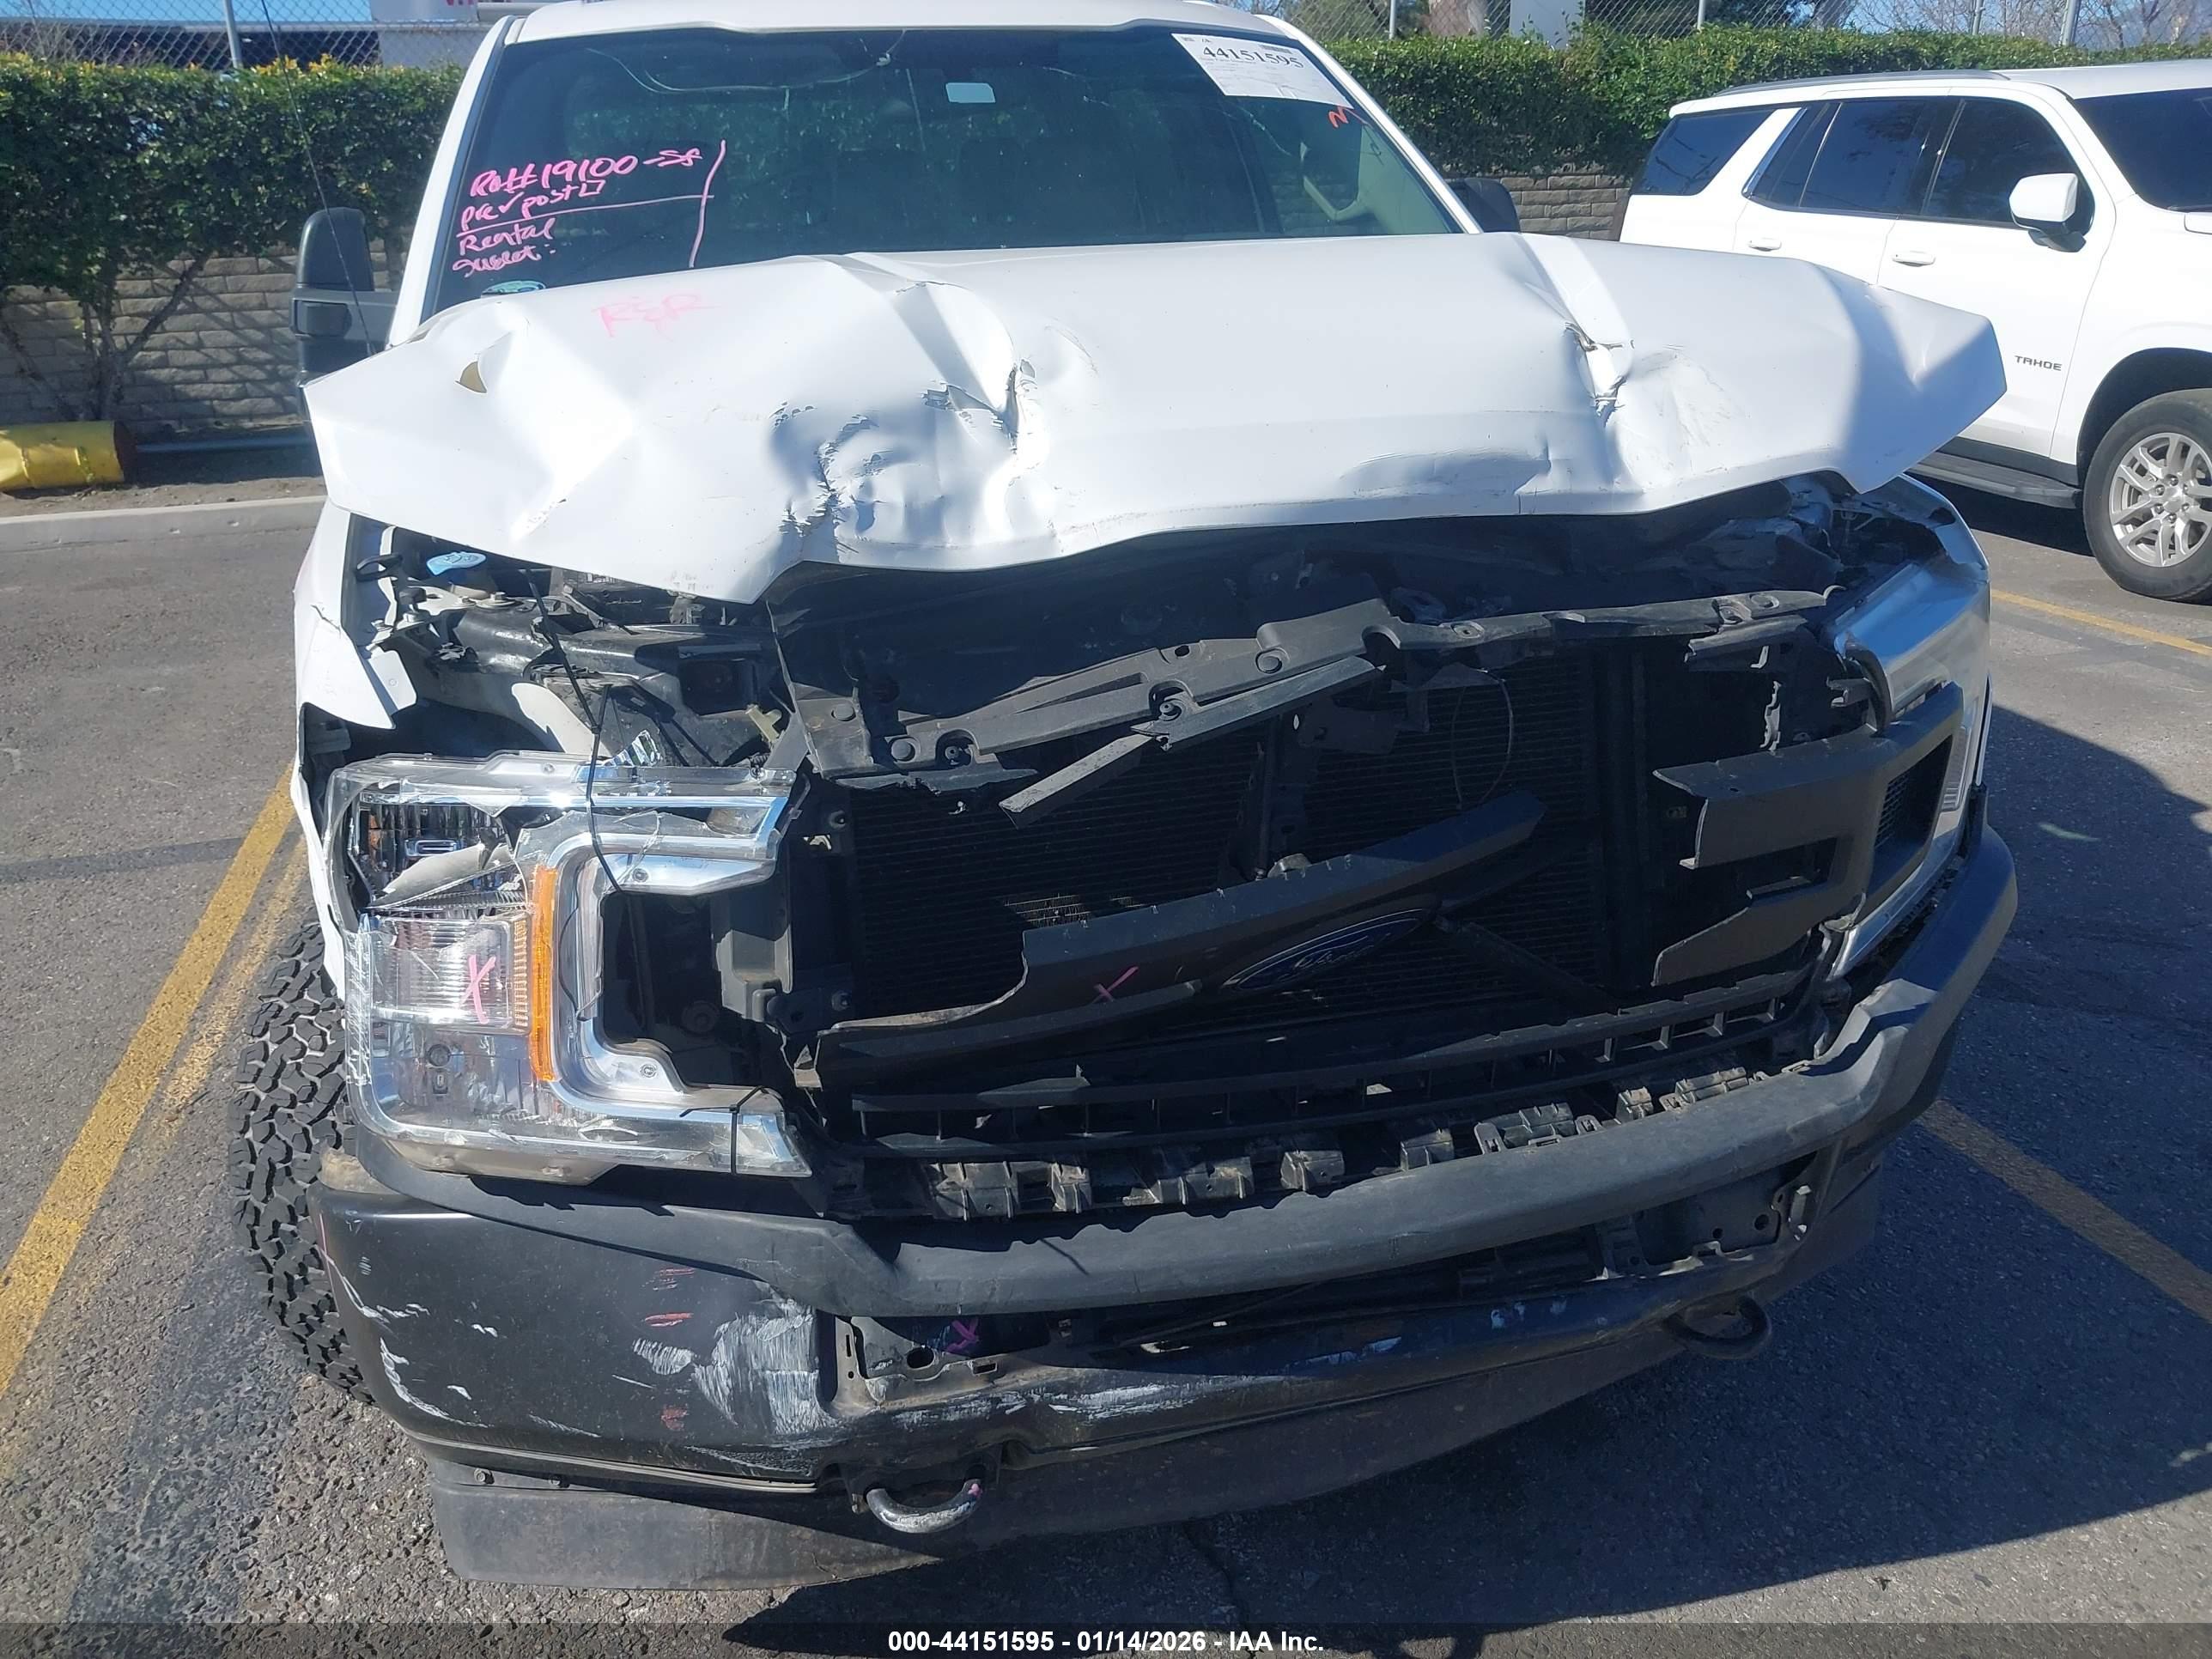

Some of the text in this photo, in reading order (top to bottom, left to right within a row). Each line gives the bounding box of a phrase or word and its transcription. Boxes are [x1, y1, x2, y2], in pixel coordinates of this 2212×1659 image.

[1203, 46, 1304, 69] 44151595
[460, 217, 556, 256] Rental
[2014, 355, 2063, 372] TAHOE
